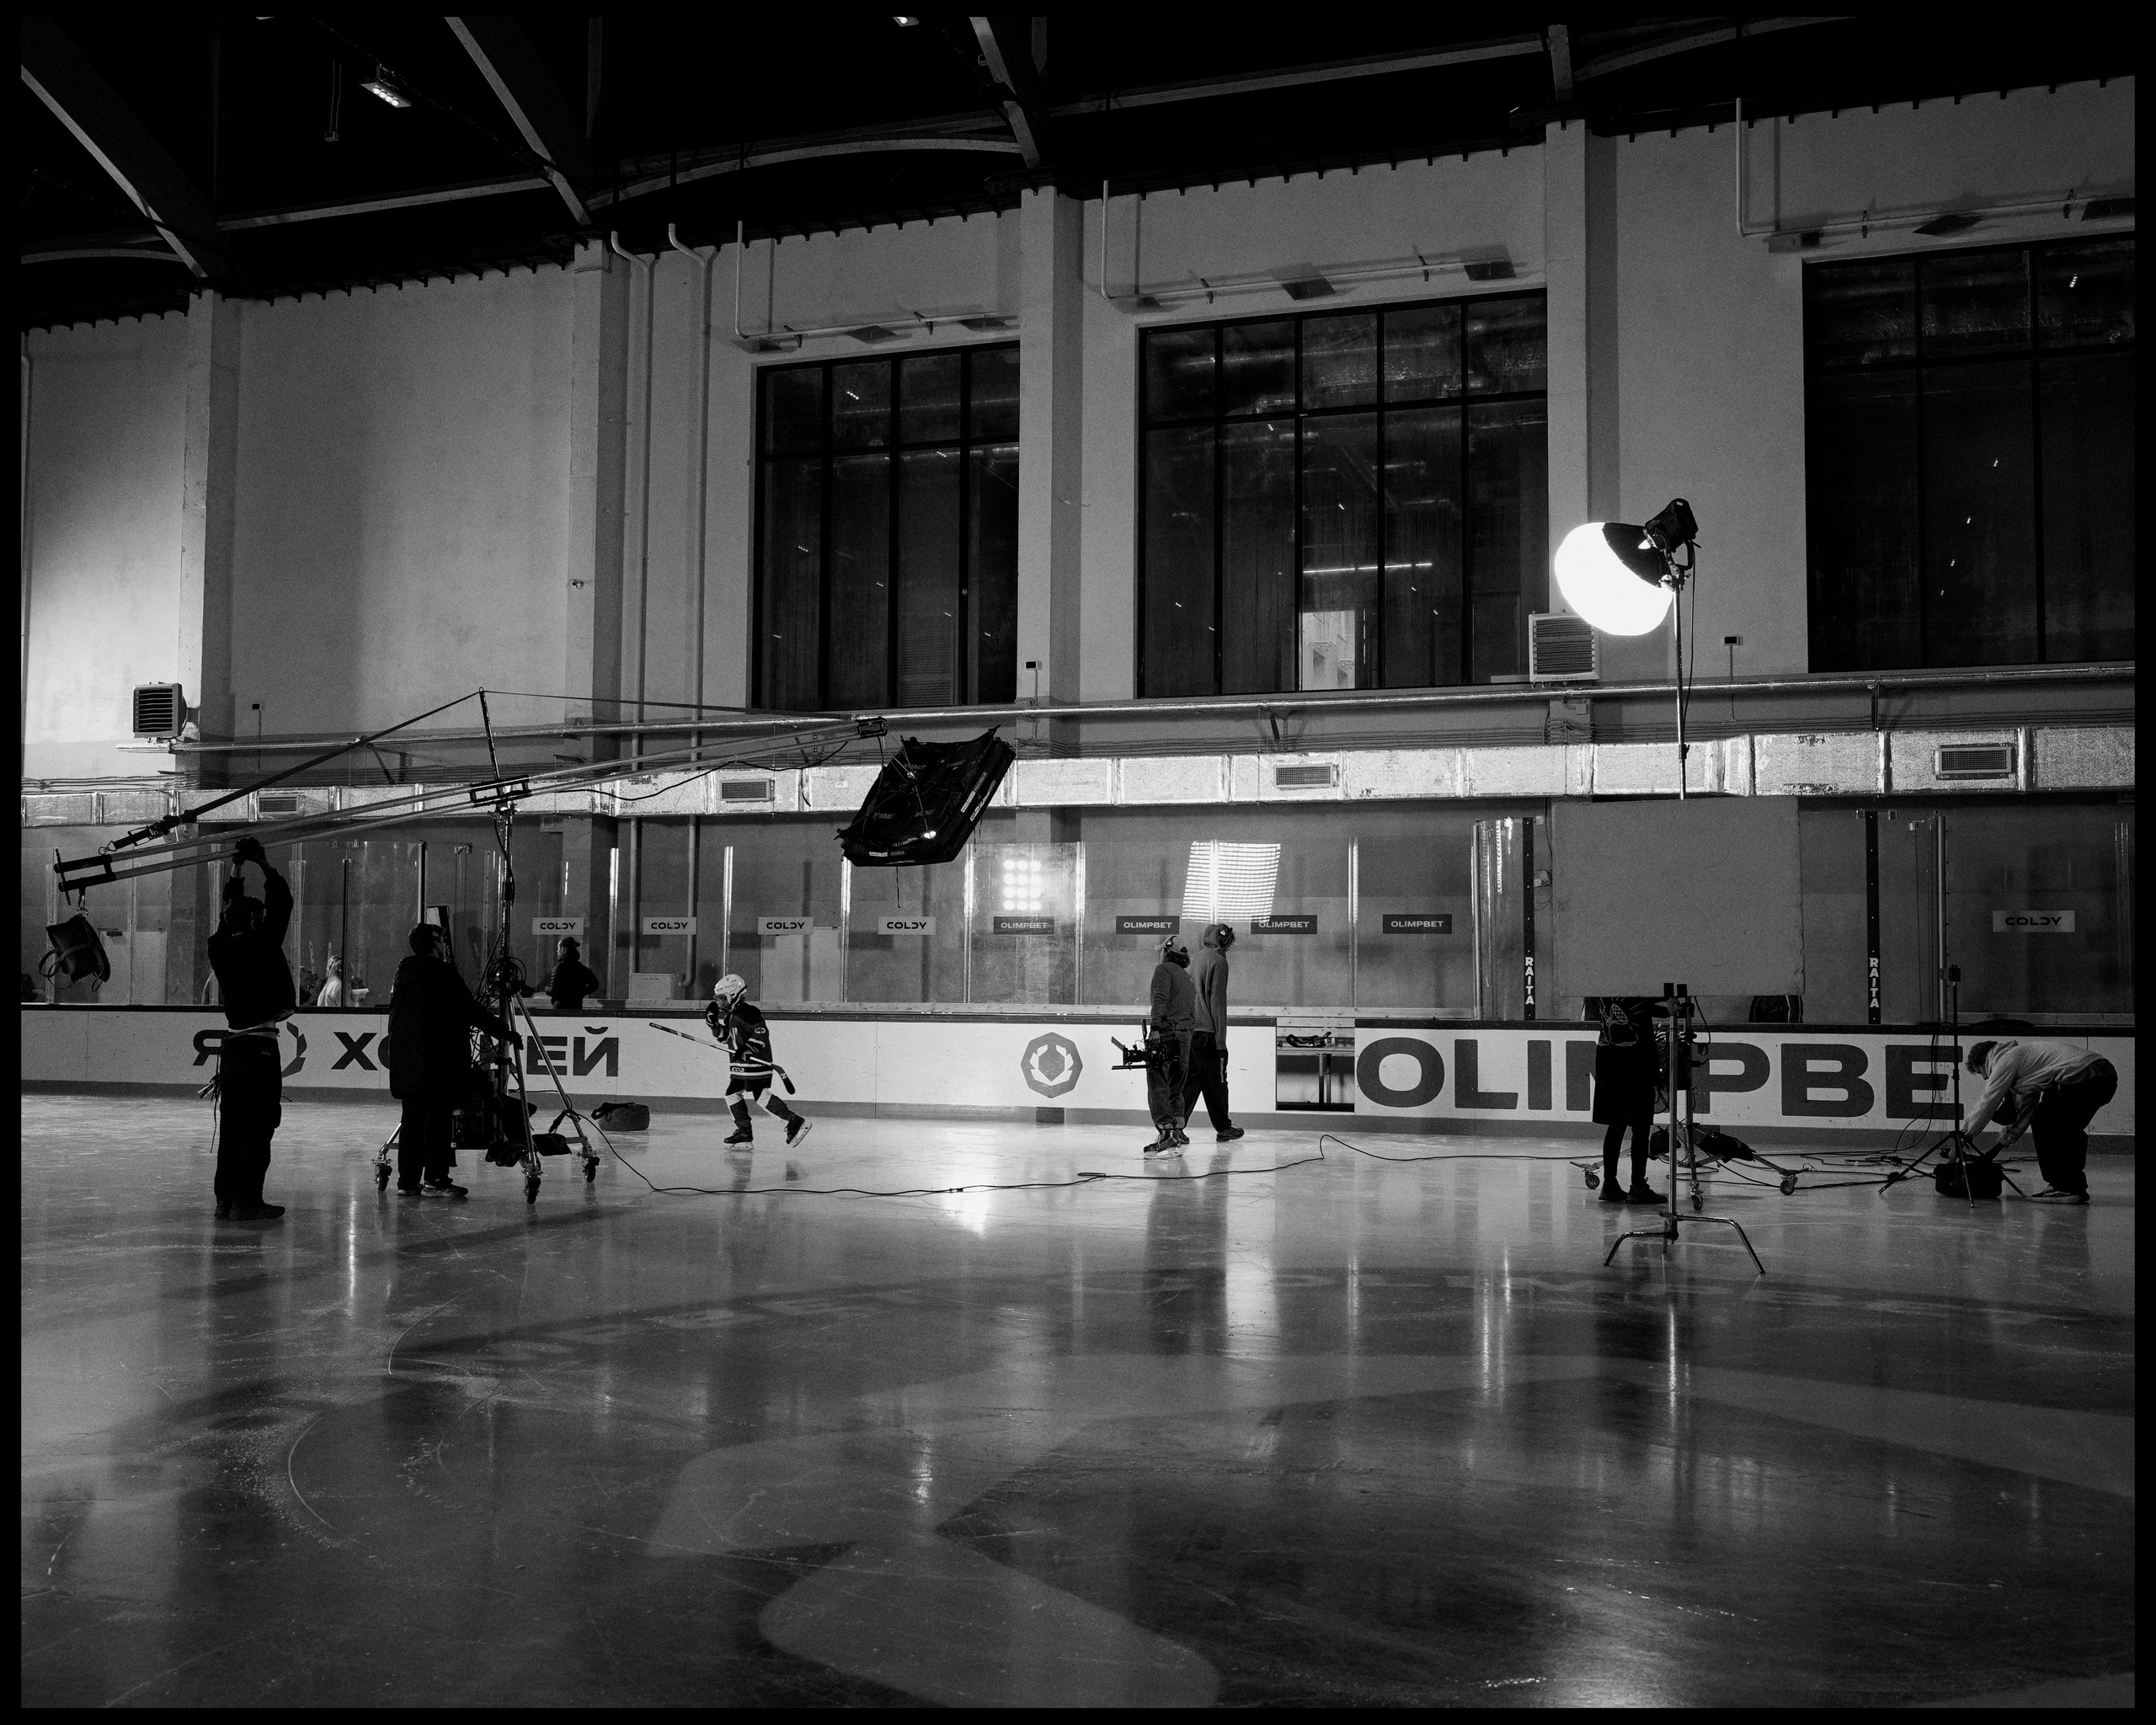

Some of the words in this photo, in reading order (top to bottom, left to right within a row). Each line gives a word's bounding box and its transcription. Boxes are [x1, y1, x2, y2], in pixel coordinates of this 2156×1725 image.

[650, 921, 689, 930] COLDY
[766, 921, 806, 930] COLDY
[886, 921, 927, 930] COLDY
[2004, 916, 2063, 926] COLDY
[1524, 957, 1534, 1005] RAITA
[1869, 957, 1880, 1008] RAITA
[330, 1026, 619, 1077] ХЕЙ
[1356, 1037, 1965, 1120] OLIPBE
